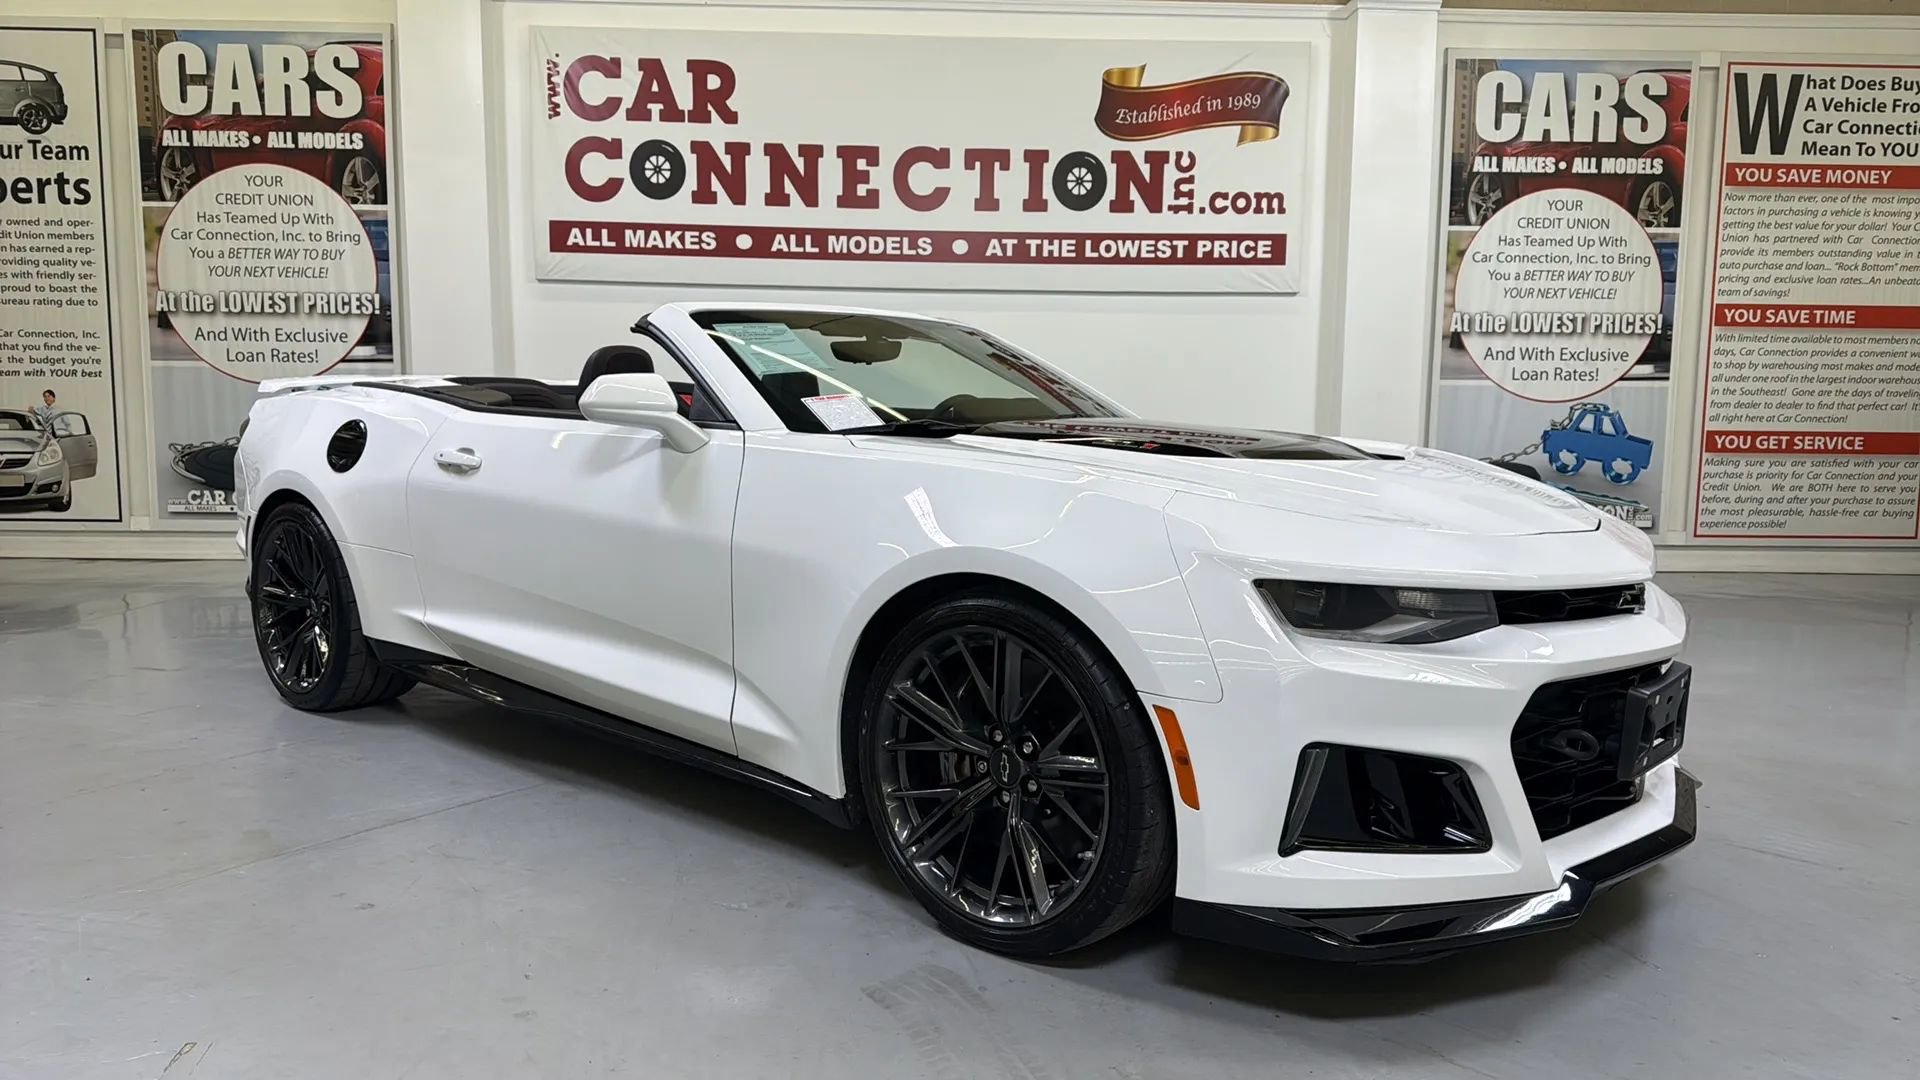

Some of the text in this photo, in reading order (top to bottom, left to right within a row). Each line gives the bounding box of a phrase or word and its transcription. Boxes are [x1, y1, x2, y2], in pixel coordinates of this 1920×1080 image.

[157, 40, 363, 119] CARS
[546, 53, 561, 120] www.
[1841, 75, 1886, 91] Does
[563, 54, 738, 125] CAR
[1115, 93, 1262, 125] Established in 1989
[1475, 70, 1668, 145] CARS
[1804, 97, 1817, 112] A
[1821, 97, 1887, 113] Vehicle
[1802, 119, 1834, 135] Car
[162, 129, 364, 150] ALL MAKES ALL MODELS
[27, 140, 90, 161] Team
[1801, 141, 1919, 158] Mean To YOU
[1472, 156, 1664, 175] ALL MAKES ALL MODELS
[244, 175, 284, 187] YOUR
[564, 135, 1170, 214] CONNECTION
[1167, 150, 1197, 215] inc
[1735, 168, 1892, 185] YOU SAVE MONEY
[215, 193, 314, 207] CREDIT UNION
[1547, 199, 1583, 212] YOUR
[6, 217, 95, 229] owned and oper-
[197, 212, 334, 227] Has Teamed Up With
[1517, 217, 1610, 230] CREDIT UNION
[14, 231, 95, 241] Union members
[170, 228, 361, 246] Car Connection, Inc. to Bring
[566, 227, 1272, 259] ALL MAKES ALL MODELS AT THE LOWEST PRICE
[1498, 235, 1628, 250] Has Teamed Up With
[189, 247, 346, 261] You a BETTER WAY TO BUY
[1472, 251, 1651, 268] Car Connection, Inc. to Bring
[208, 265, 329, 279] YOUR NEXT VEHICLE!
[1488, 269, 1636, 282] You a BETTER WAY TO BUY
[1, 284, 98, 294] proud to boast the
[1503, 287, 1617, 300] YOUR NEXT VEHICLE!
[1718, 288, 1791, 299] team of savings!
[156, 290, 381, 315] At the LOWEST PRICES!
[1450, 311, 1664, 335] At the LOWEST PRICES!
[1724, 308, 1856, 325] YOU SAVE TIME
[17, 329, 101, 340] Connection, Inc.
[194, 327, 349, 343] And With Exclusive
[7, 355, 102, 366] the budget you're
[226, 348, 319, 363] Loan Rates!
[1483, 346, 1630, 363] And With Exclusive
[24, 368, 103, 378] with YOUR best
[1511, 367, 1599, 382] Loan Rates!
[1708, 414, 1848, 425] all right here at Car Connection!
[1714, 435, 1865, 450] YOU GET SERVICE
[1704, 458, 1919, 470] Making sure you are satisfied with your car
[188, 490, 226, 505] CAR
[1700, 520, 1788, 530] experience possible!
